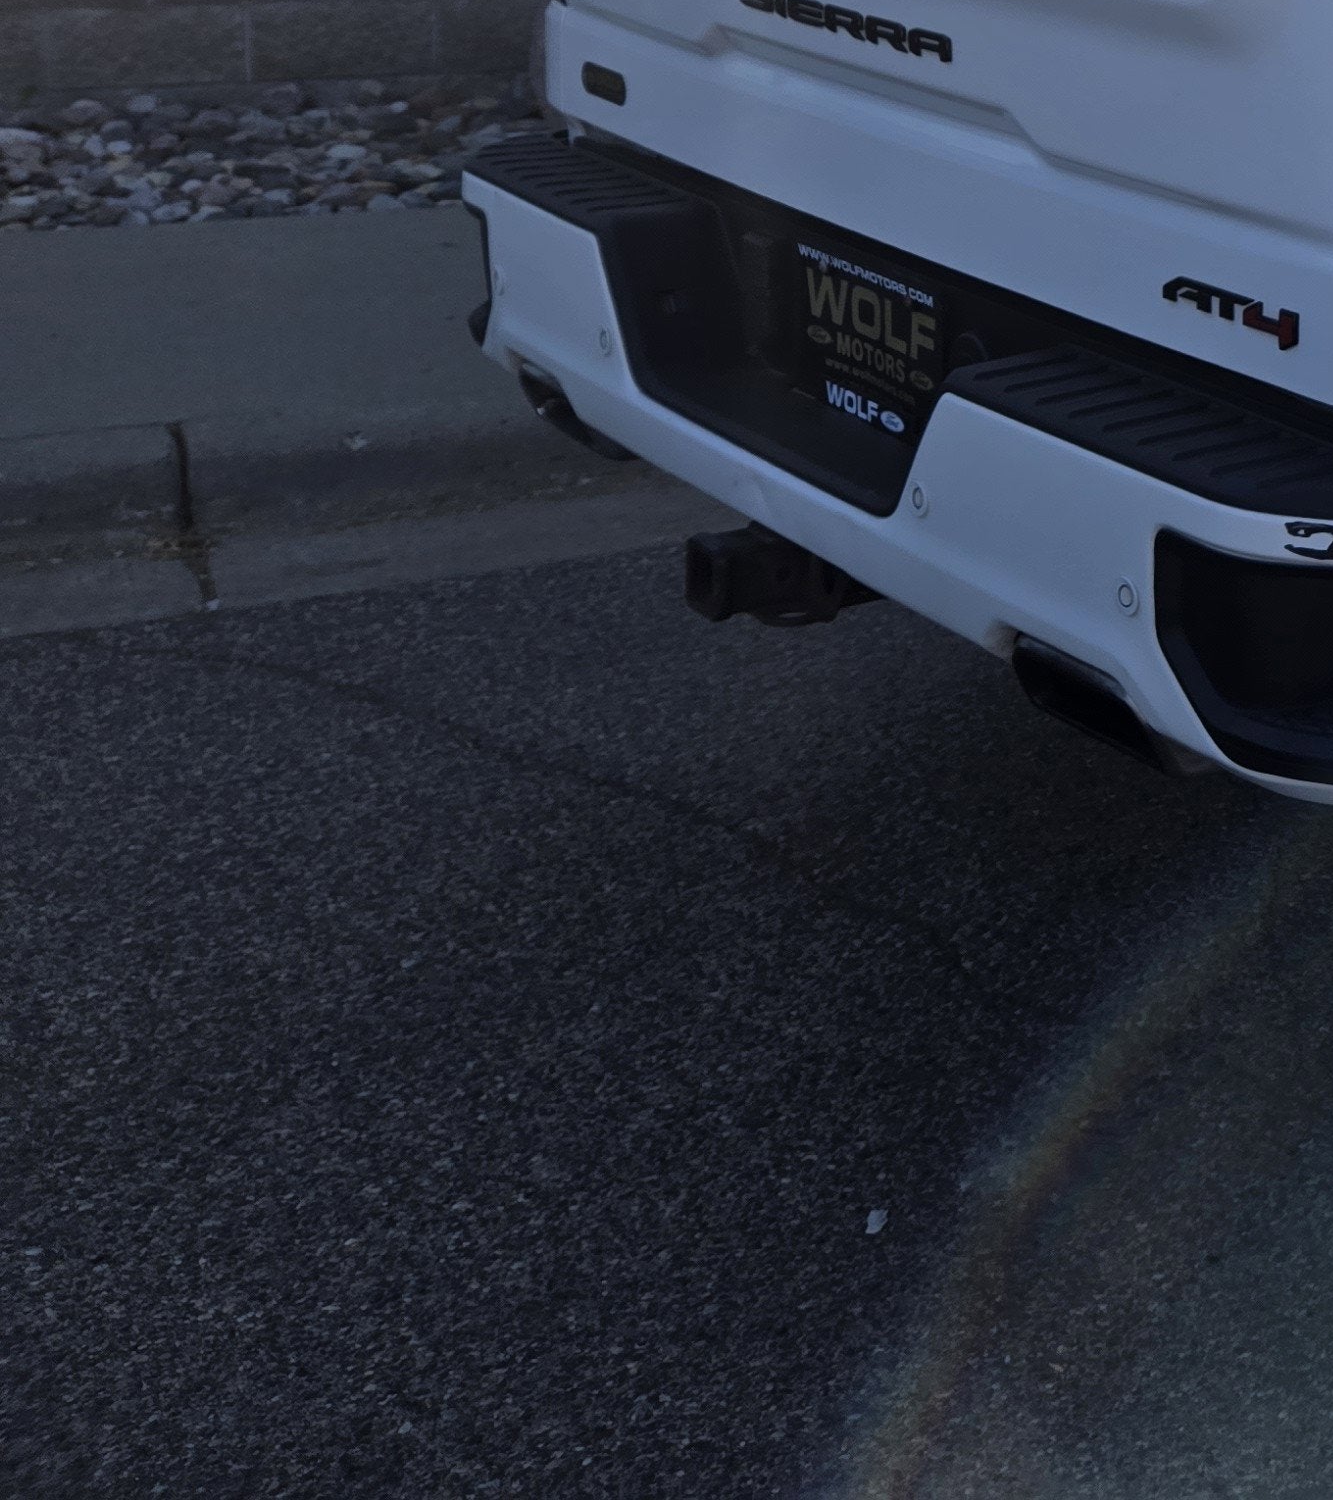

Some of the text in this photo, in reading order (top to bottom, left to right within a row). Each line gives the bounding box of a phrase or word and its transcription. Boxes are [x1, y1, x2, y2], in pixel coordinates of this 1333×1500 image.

[797, 243, 934, 307] WWW.WOLFMOTORS.COM
[806, 267, 936, 360] WOLF
[1162, 275, 1300, 351] AT4
[836, 331, 905, 383] MOTORS
[825, 380, 879, 422] WOLF
